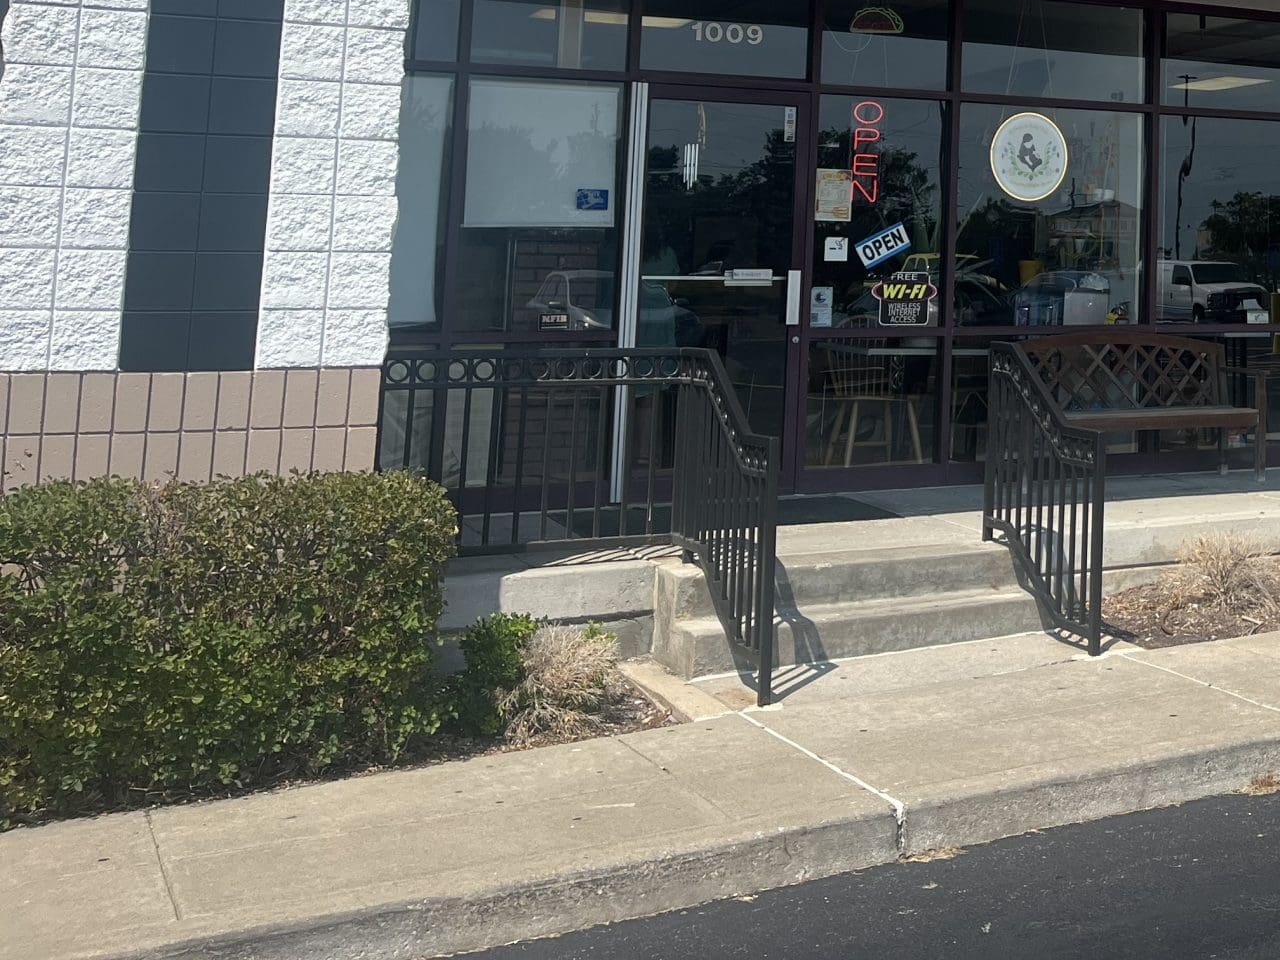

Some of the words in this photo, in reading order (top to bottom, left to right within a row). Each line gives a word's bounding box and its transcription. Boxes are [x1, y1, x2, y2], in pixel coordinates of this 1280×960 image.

[691, 22, 763, 45] 1009
[849, 101, 883, 203] OPEN
[862, 228, 905, 261] OPEN
[891, 273, 919, 281] FREE
[883, 284, 927, 299] WI-FI
[887, 302, 921, 310] WIRELESS
[887, 308, 921, 316] INTERNET
[890, 315, 916, 323] ACCESS
